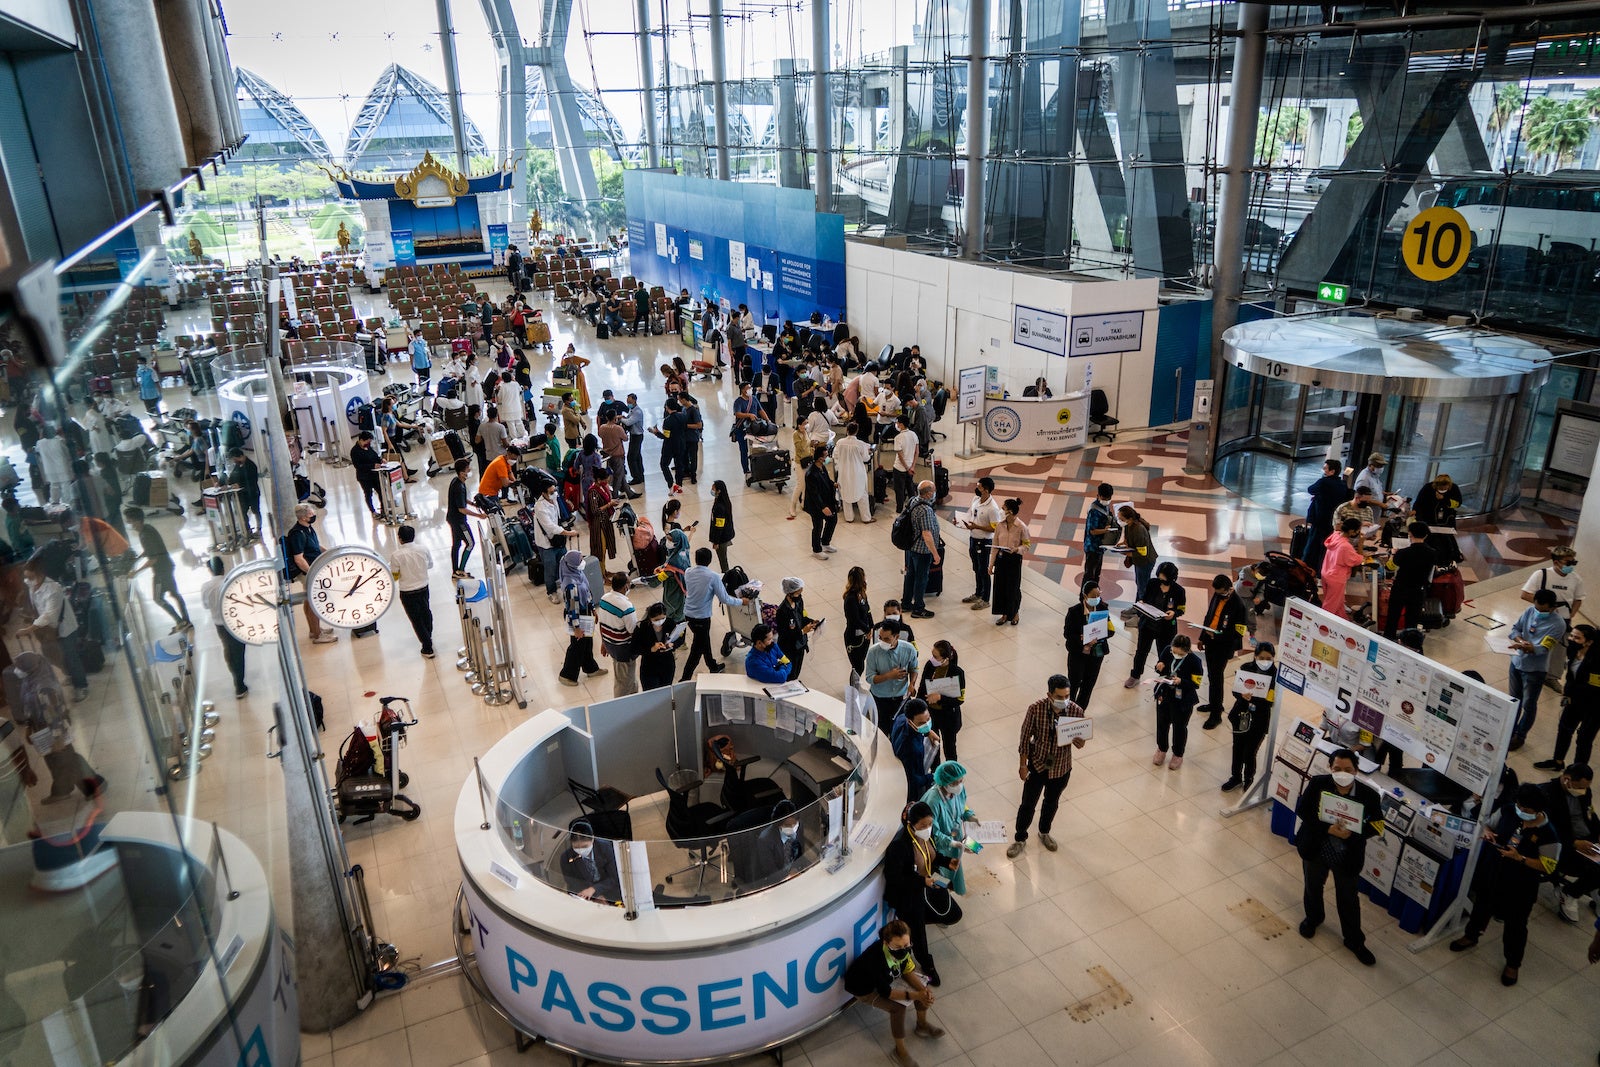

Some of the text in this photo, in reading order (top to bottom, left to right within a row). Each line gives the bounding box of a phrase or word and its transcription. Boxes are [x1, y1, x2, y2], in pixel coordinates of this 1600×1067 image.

[1413, 221, 1462, 269] 10
[1031, 331, 1062, 343] SUVARNABHUMI
[1095, 334, 1137, 343] SUVARNABHUMI
[1266, 361, 1282, 377] 10
[993, 421, 1012, 429] SHA
[1059, 433, 1077, 441] SERVICE
[329, 566, 340, 578] 11
[342, 561, 355, 573] 12
[361, 562, 365, 572] 1
[319, 578, 332, 590] 10
[376, 580, 386, 591] 3
[318, 591, 328, 603] 9
[374, 593, 384, 603] 4
[325, 603, 335, 613] 8
[365, 603, 375, 614] 5
[338, 609, 347, 620] 7
[351, 609, 361, 620] 6
[1335, 687, 1352, 714] 5
[1357, 687, 1390, 708] CHILLAX
